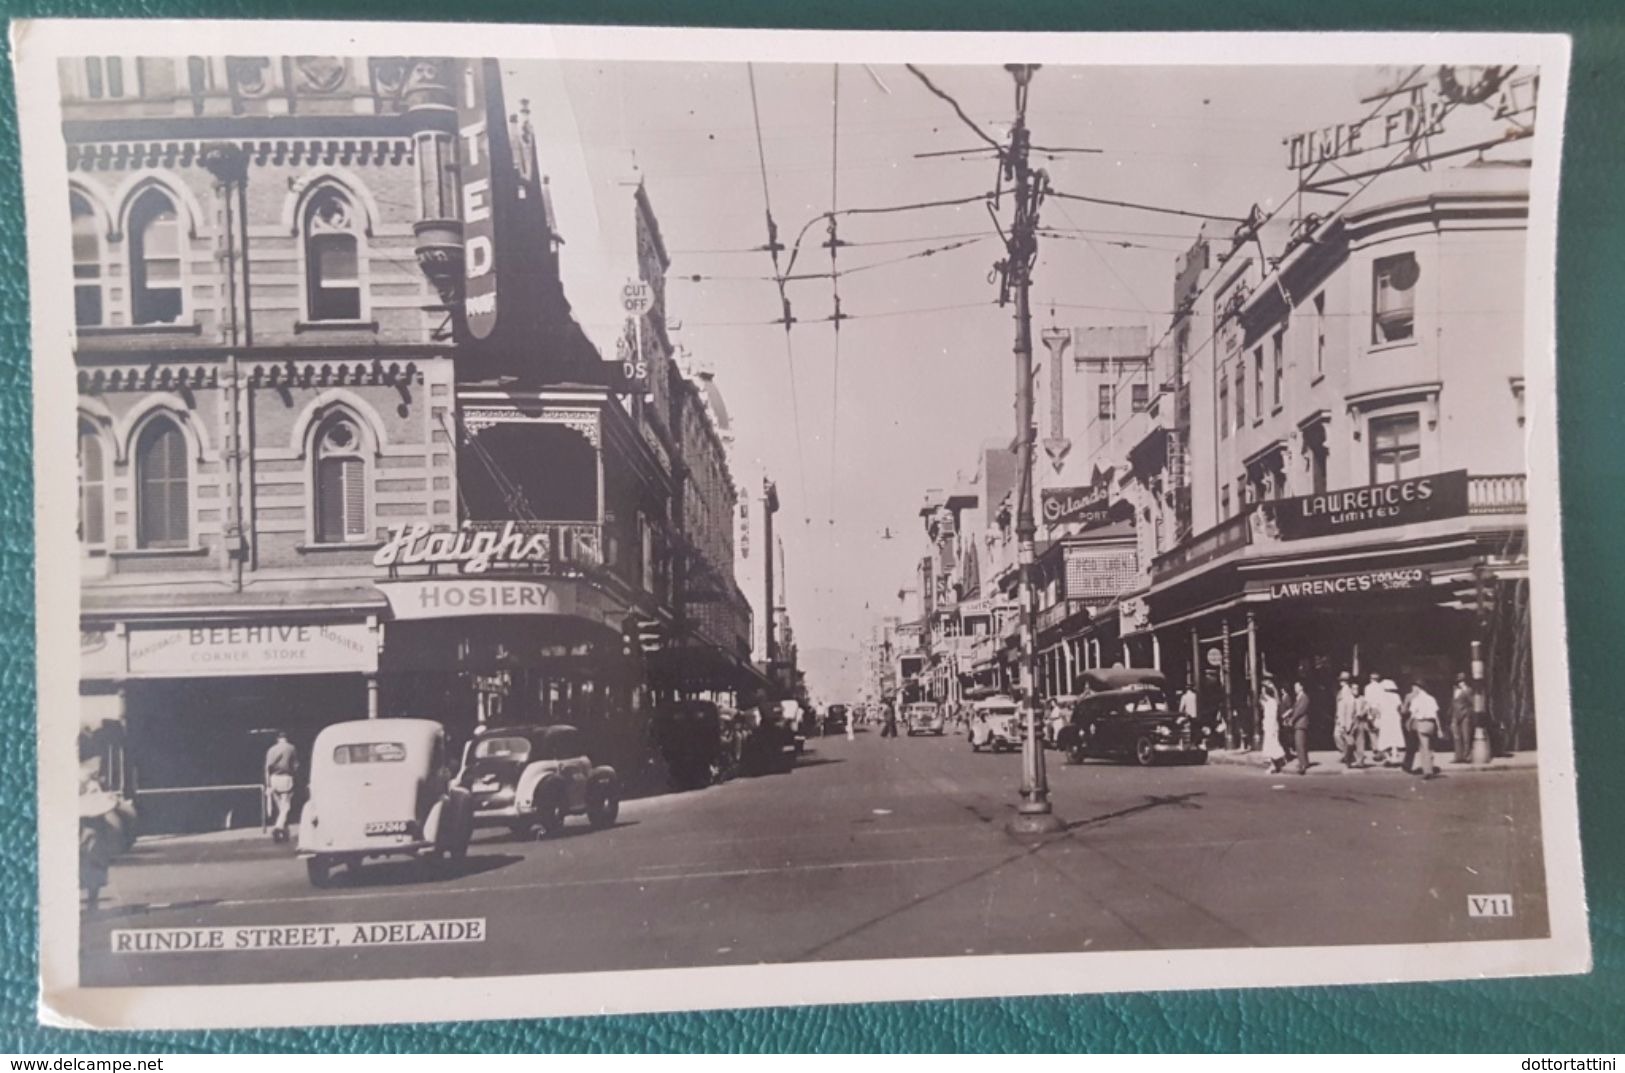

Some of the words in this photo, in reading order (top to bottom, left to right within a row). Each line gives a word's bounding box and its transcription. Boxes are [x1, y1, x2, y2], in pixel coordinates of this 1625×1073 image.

[1283, 123, 1362, 170] TIME
[1384, 100, 1446, 148] FOR
[623, 285, 647, 297] CUT
[624, 298, 647, 311] OFF
[1302, 480, 1433, 517] LAWRENCES
[1079, 510, 1108, 519] PORT
[1331, 506, 1400, 524] LIMITED
[373, 520, 551, 573] Haighs
[419, 585, 550, 608] HOSIERY
[1270, 576, 1371, 600] LAWRENCE'S
[188, 625, 312, 646] BEEHIVE
